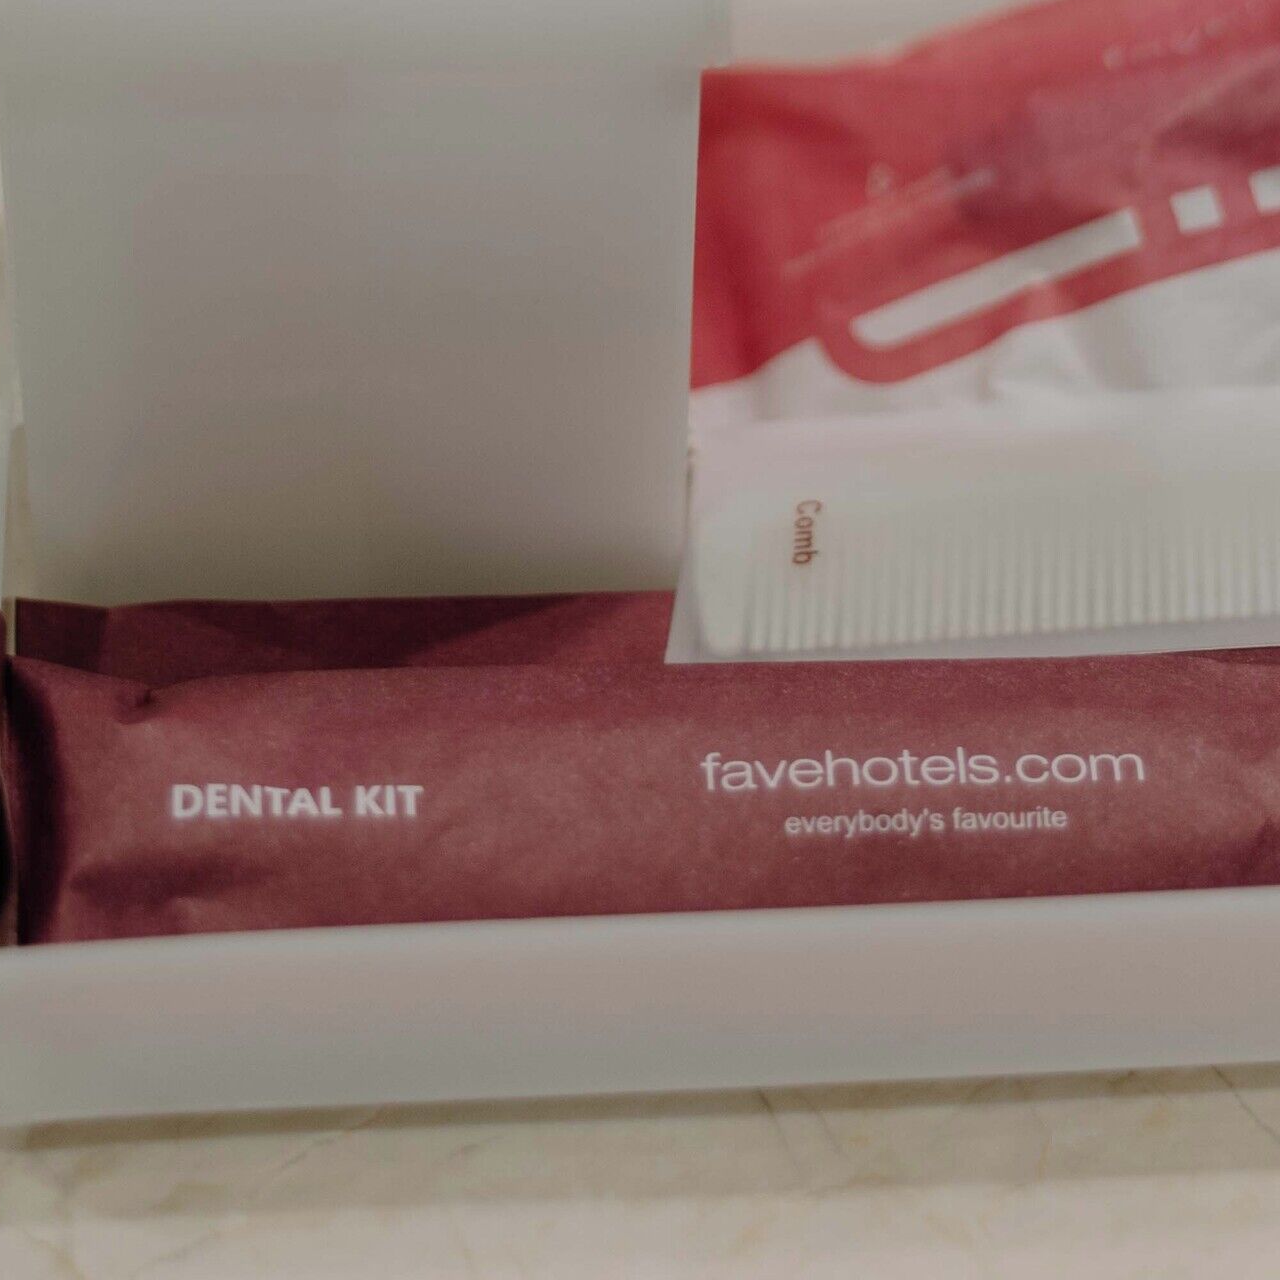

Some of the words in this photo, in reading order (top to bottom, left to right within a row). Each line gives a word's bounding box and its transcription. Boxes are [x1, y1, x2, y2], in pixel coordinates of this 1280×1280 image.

[792, 499, 823, 564] Comb
[699, 745, 1146, 791] favehotels.com
[172, 782, 343, 819] DENTAL
[354, 784, 425, 818] KIT
[783, 808, 945, 839] everybody's
[952, 805, 1069, 832] favourite
